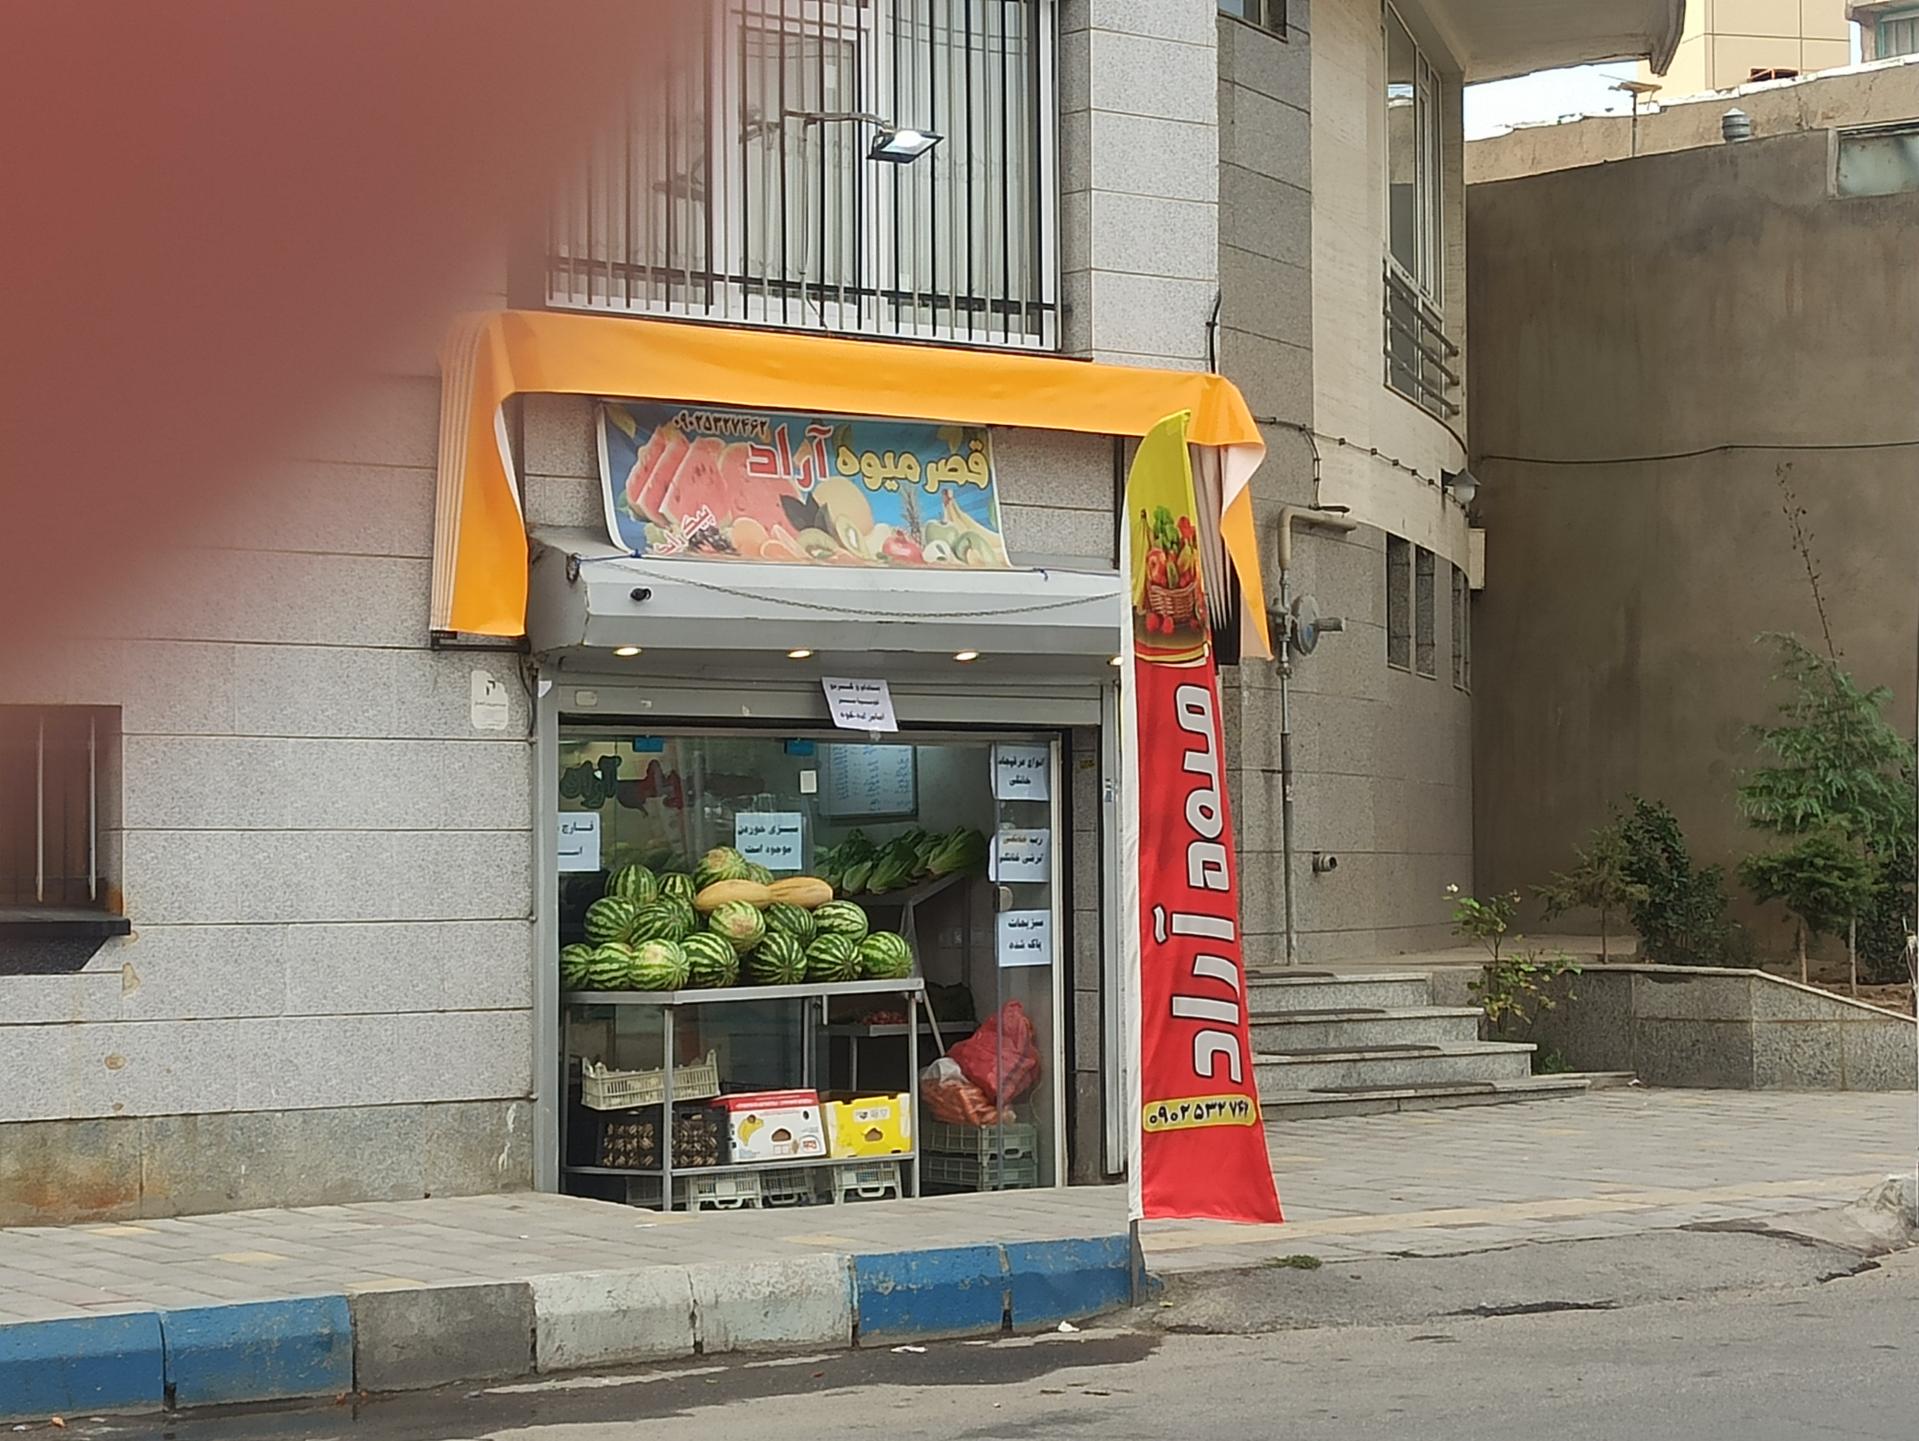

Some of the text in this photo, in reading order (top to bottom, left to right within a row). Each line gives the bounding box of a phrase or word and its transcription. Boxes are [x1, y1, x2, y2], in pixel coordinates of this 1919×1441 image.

[747, 423, 990, 493] قصر میوه آراد
[744, 843, 792, 856] موجود است
[1007, 917, 1044, 929] سبزیجات
[1009, 938, 1042, 952] پاک شده
[1151, 904, 1244, 1085] آراد
